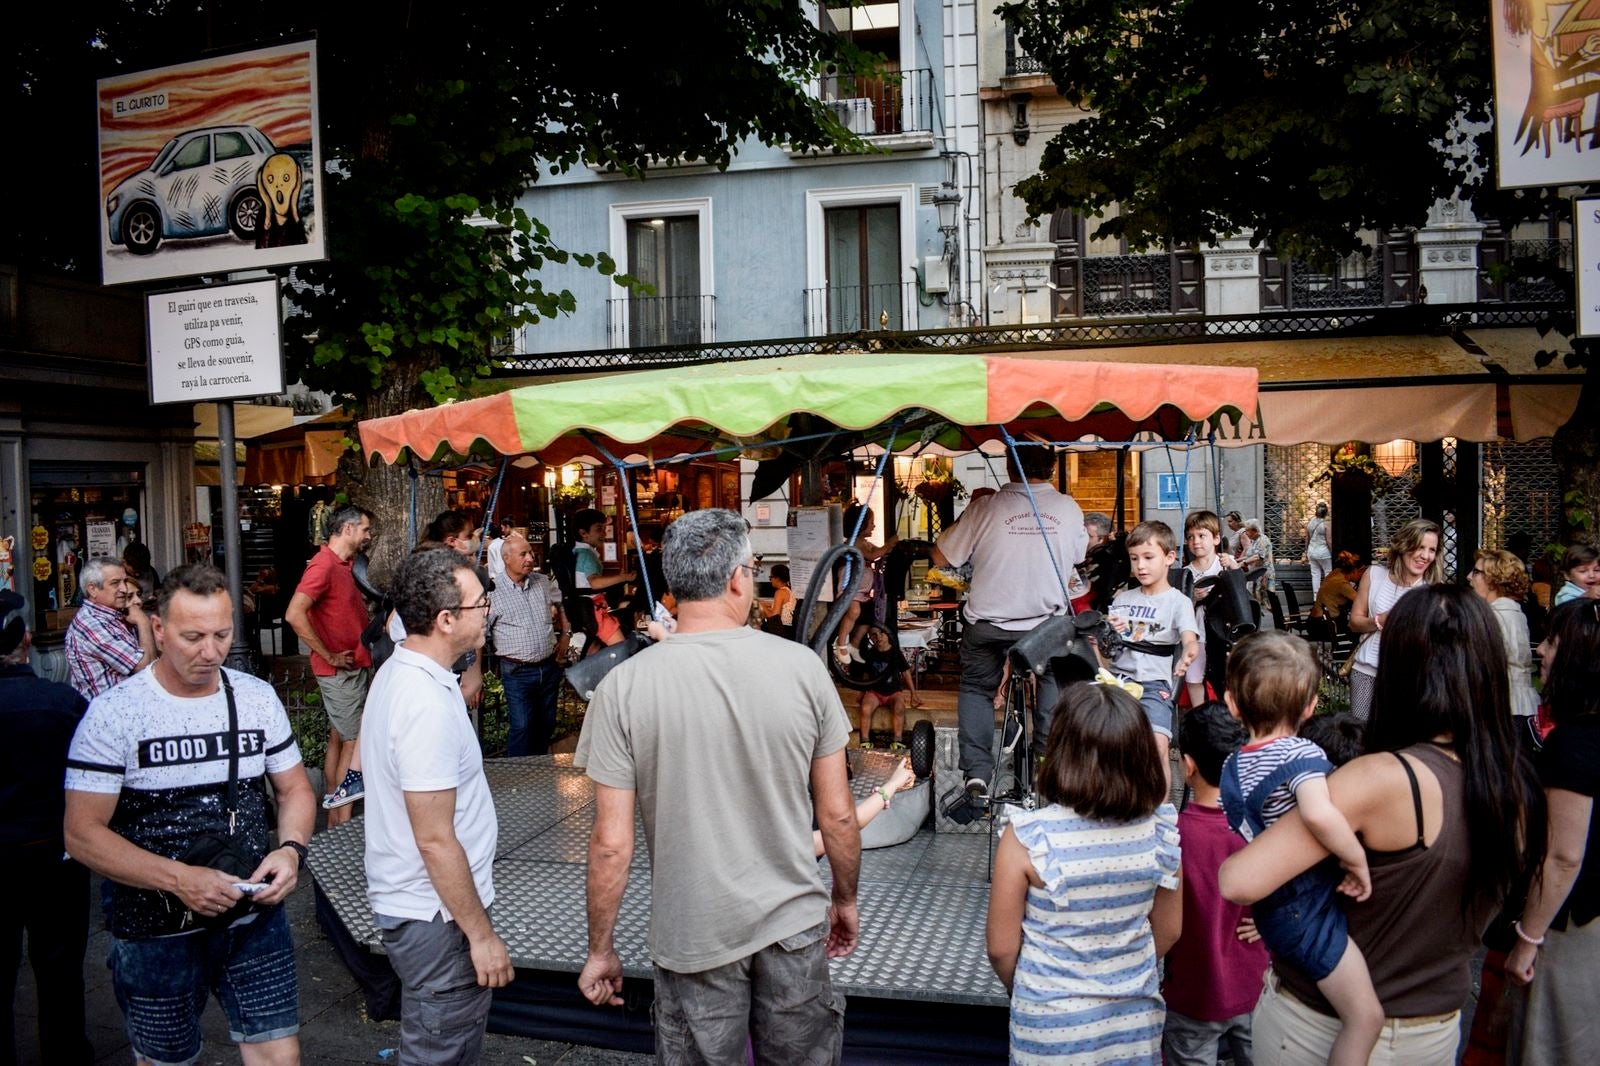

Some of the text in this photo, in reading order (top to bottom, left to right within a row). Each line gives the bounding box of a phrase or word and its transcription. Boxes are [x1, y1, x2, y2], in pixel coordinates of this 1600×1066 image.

[116, 94, 165, 113] EL GUIRITO
[168, 301, 177, 313] El
[178, 299, 196, 316] guiri
[198, 301, 212, 313] que
[213, 299, 223, 308] en
[184, 313, 244, 331] utiliza pa venir,
[184, 337, 201, 349] GPS
[202, 338, 224, 348] como
[177, 351, 254, 369] se lleva de souvenir,
[200, 376, 208, 387] la
[1166, 476, 1181, 493] H
[1128, 605, 1157, 619] STILL
[149, 732, 260, 763] GOOD LFE
